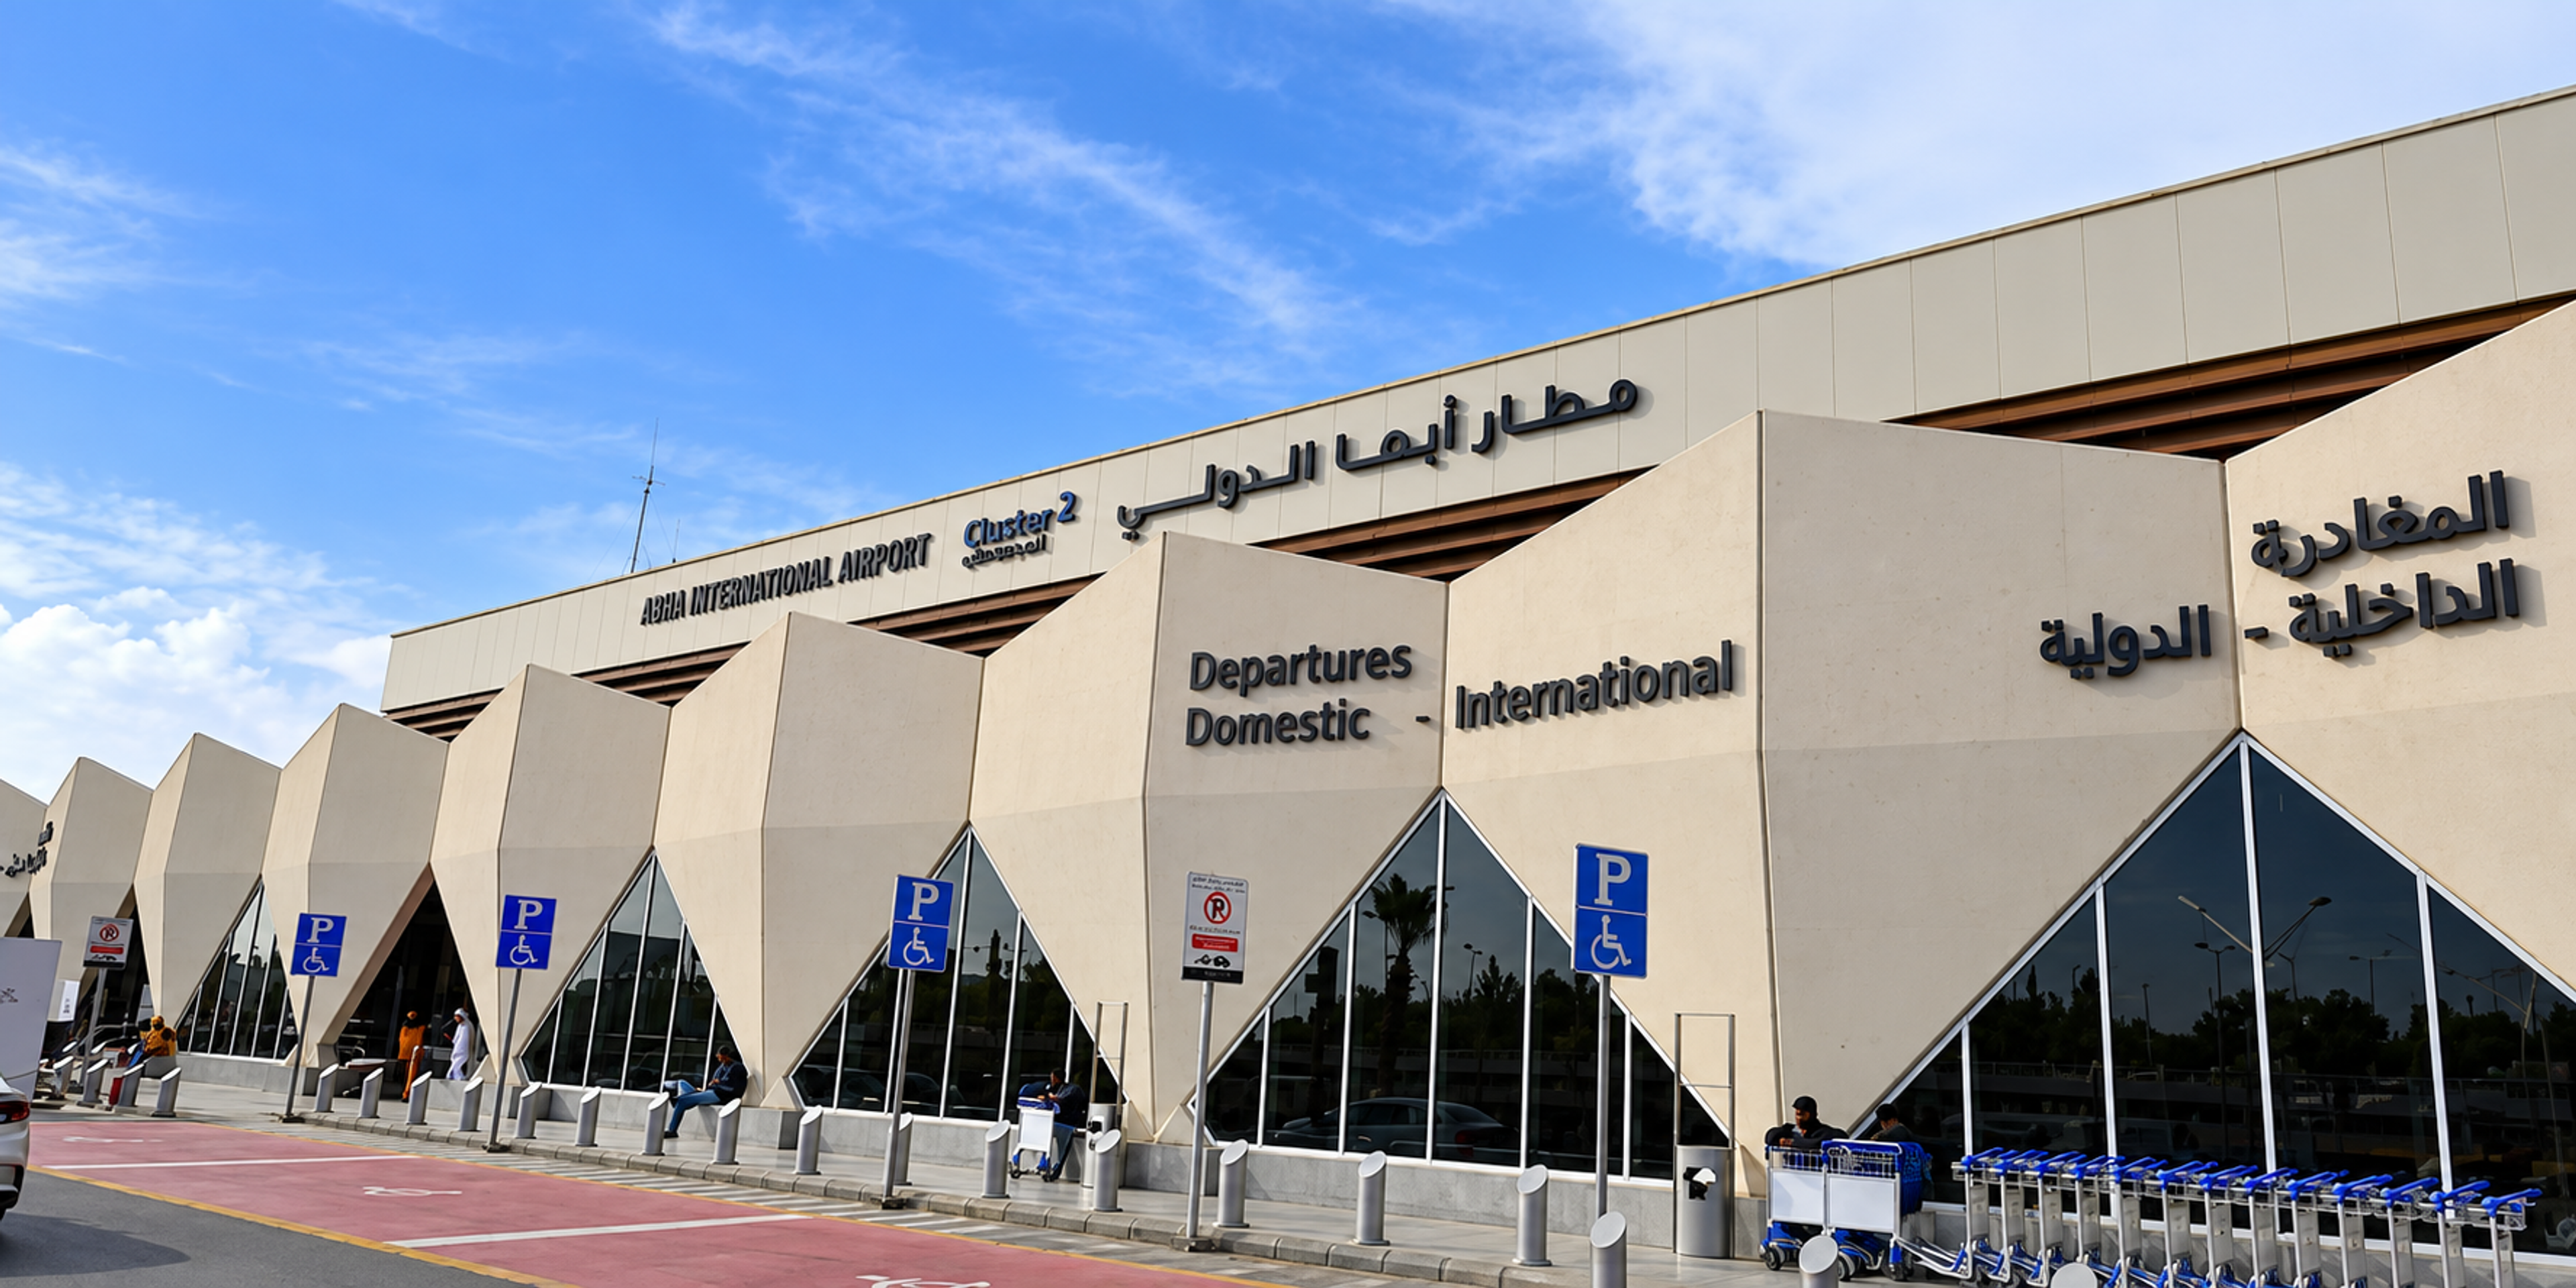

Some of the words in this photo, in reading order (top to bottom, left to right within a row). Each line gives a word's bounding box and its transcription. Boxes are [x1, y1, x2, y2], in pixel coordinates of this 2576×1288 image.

[1336, 394, 1456, 470] أبها
[1471, 379, 1638, 453] مطار
[963, 508, 1055, 548] Cluster
[1057, 491, 1077, 523] 2
[1117, 440, 1316, 541] الدولي
[2251, 470, 2510, 577] المغادرة
[641, 590, 686, 625] ABHA
[690, 556, 833, 616] INTERNATIONAL
[838, 533, 932, 584] AIRPORT
[2289, 558, 2520, 658] الداخلية
[1189, 644, 1413, 697] Departures
[2039, 604, 2212, 680] الدولية
[1186, 698, 1371, 747] Domestic
[1455, 639, 1733, 729] International
[514, 900, 543, 930] P
[908, 881, 938, 921] P
[1594, 853, 1631, 906] P
[307, 917, 334, 943] P
